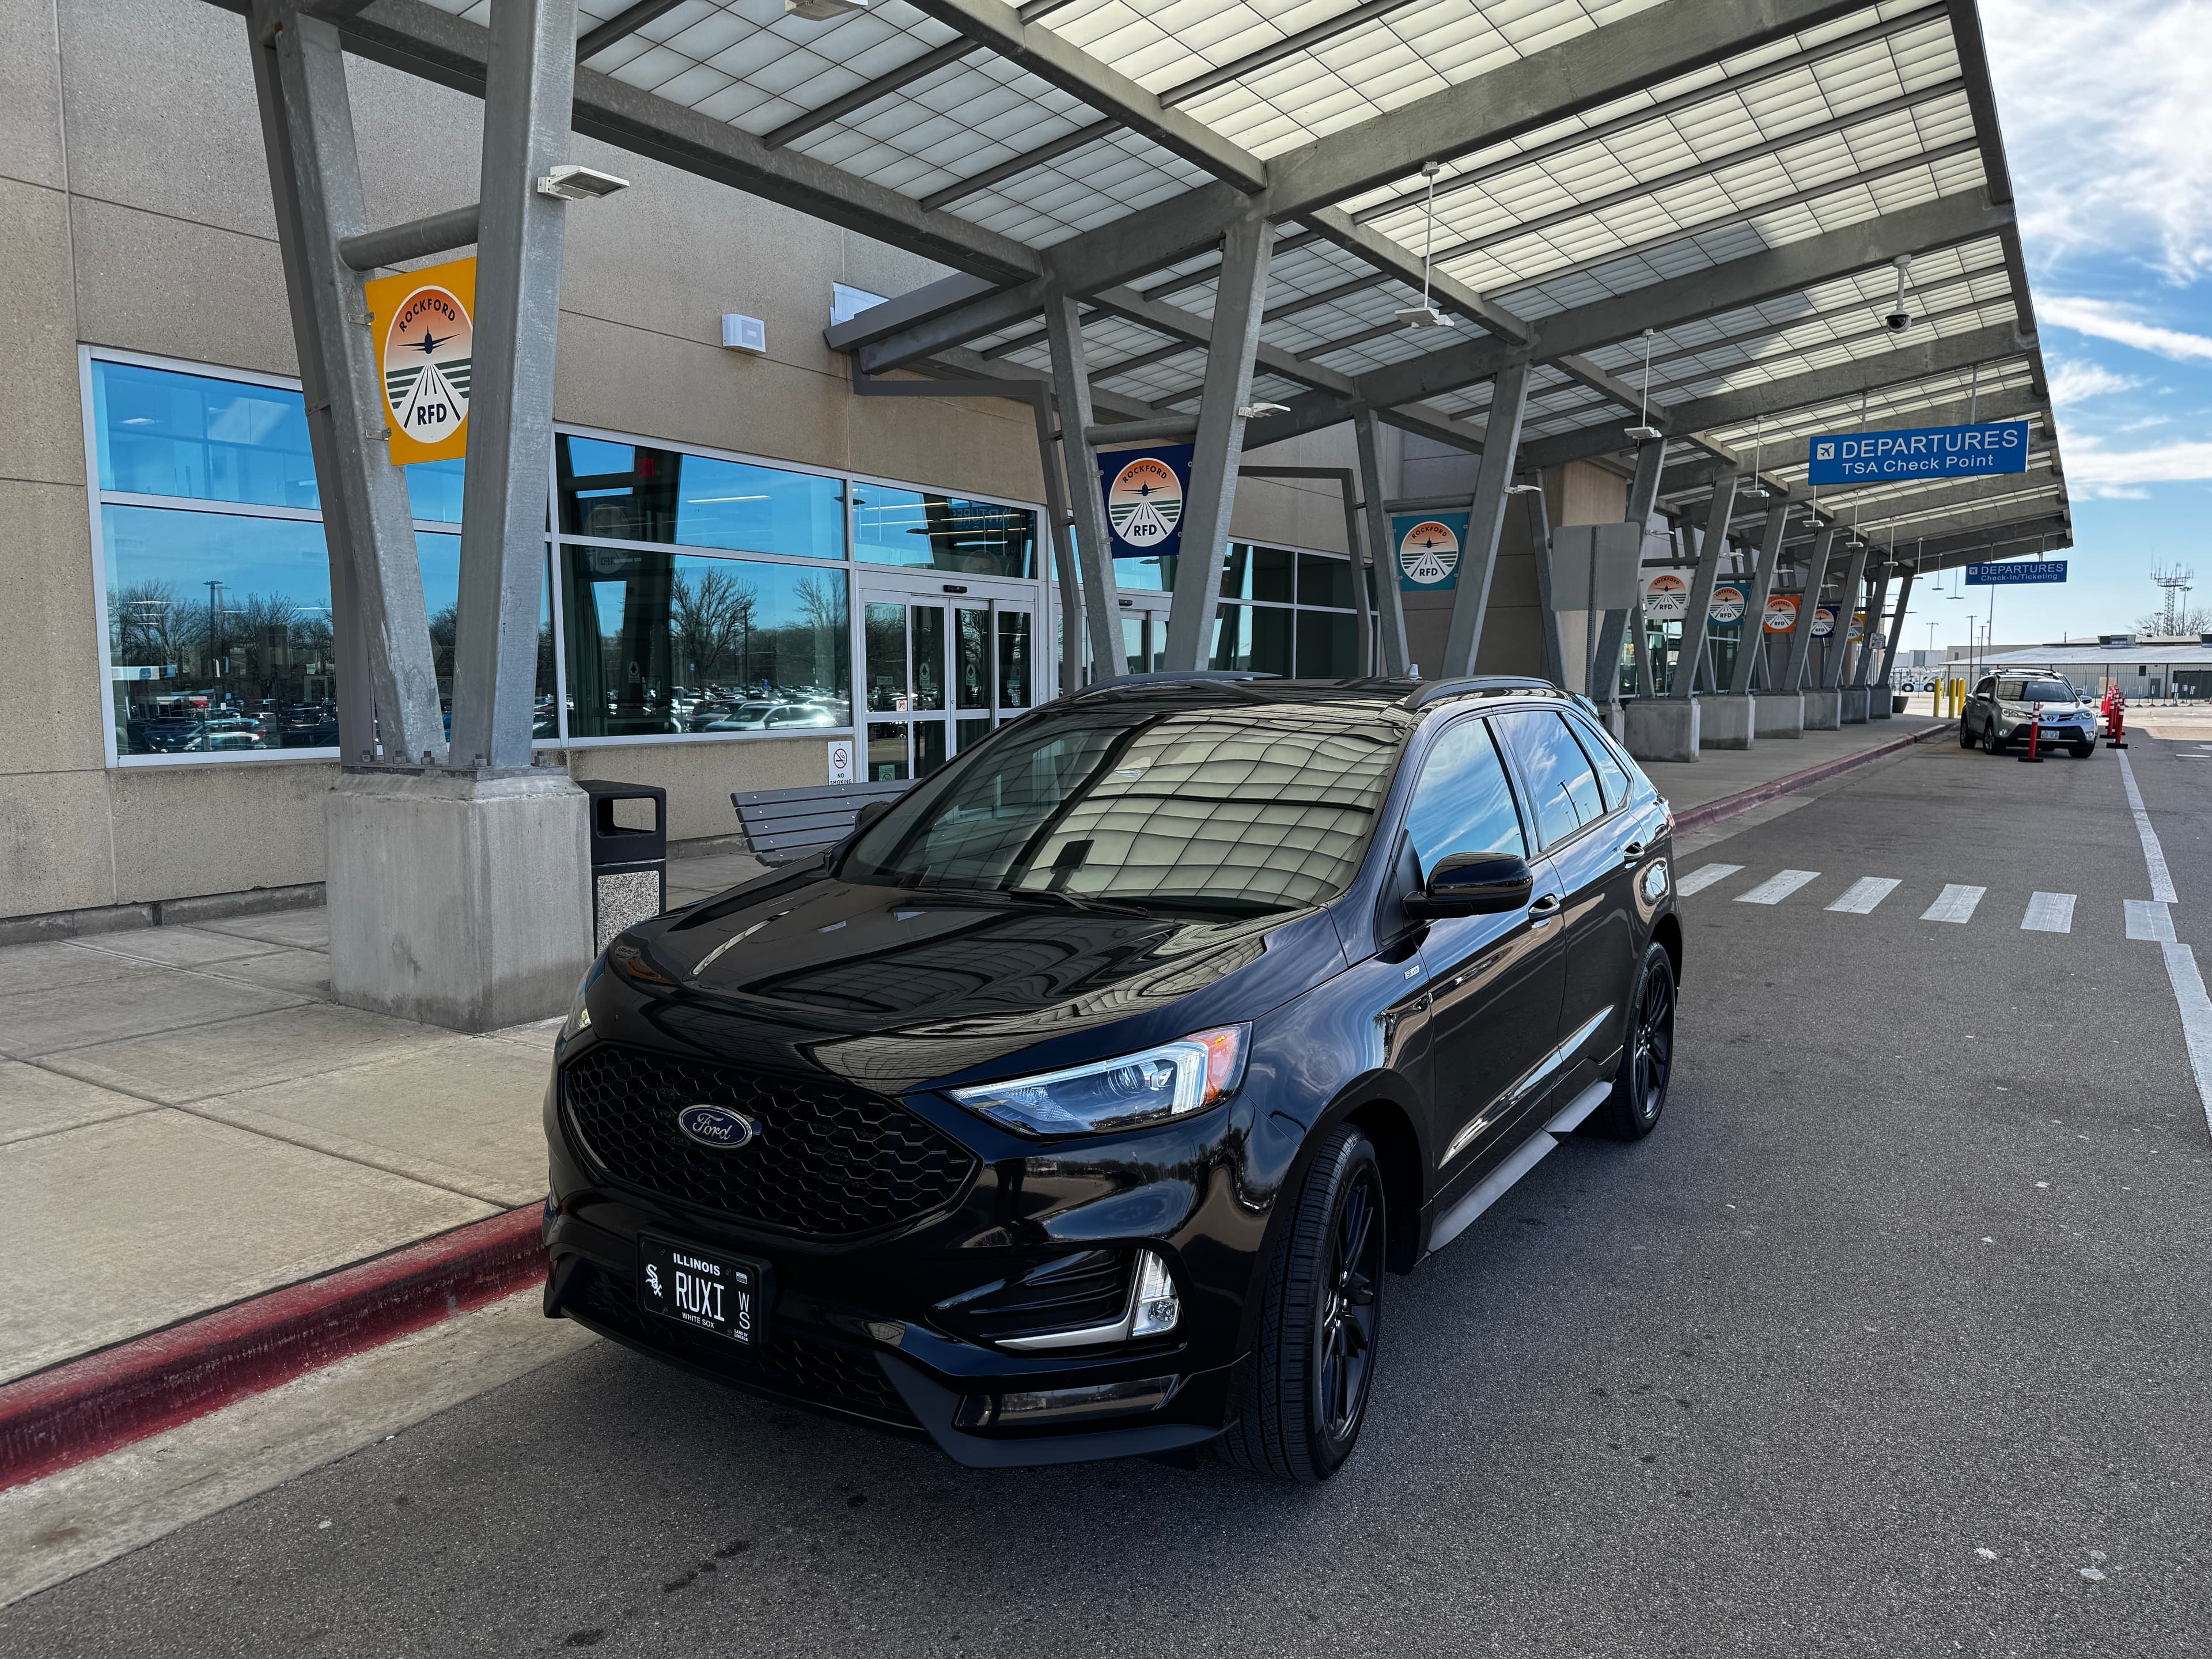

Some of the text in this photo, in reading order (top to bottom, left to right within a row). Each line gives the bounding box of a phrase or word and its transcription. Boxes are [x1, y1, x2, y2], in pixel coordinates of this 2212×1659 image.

[399, 298, 455, 332] ROCKFORD
[417, 403, 447, 426] RFD
[1842, 429, 2018, 459] DEPARTURES
[1842, 454, 1994, 475] TSA Check Point
[1123, 465, 1167, 483] ROCKFORD
[1134, 524, 1157, 536] RFD
[1411, 526, 1447, 540] ROCKFORD
[1419, 568, 1438, 577] RFD
[1980, 573, 2058, 581] Check-In/Ticketing
[1981, 563, 2064, 575] DEPARTURES
[1654, 577, 1679, 585] ROCKFORD
[692, 1113, 732, 1140] Ford
[673, 1252, 721, 1276] ILLINOIS
[676, 1271, 725, 1322] RUXI
[682, 1312, 715, 1328] WHITE SOX
